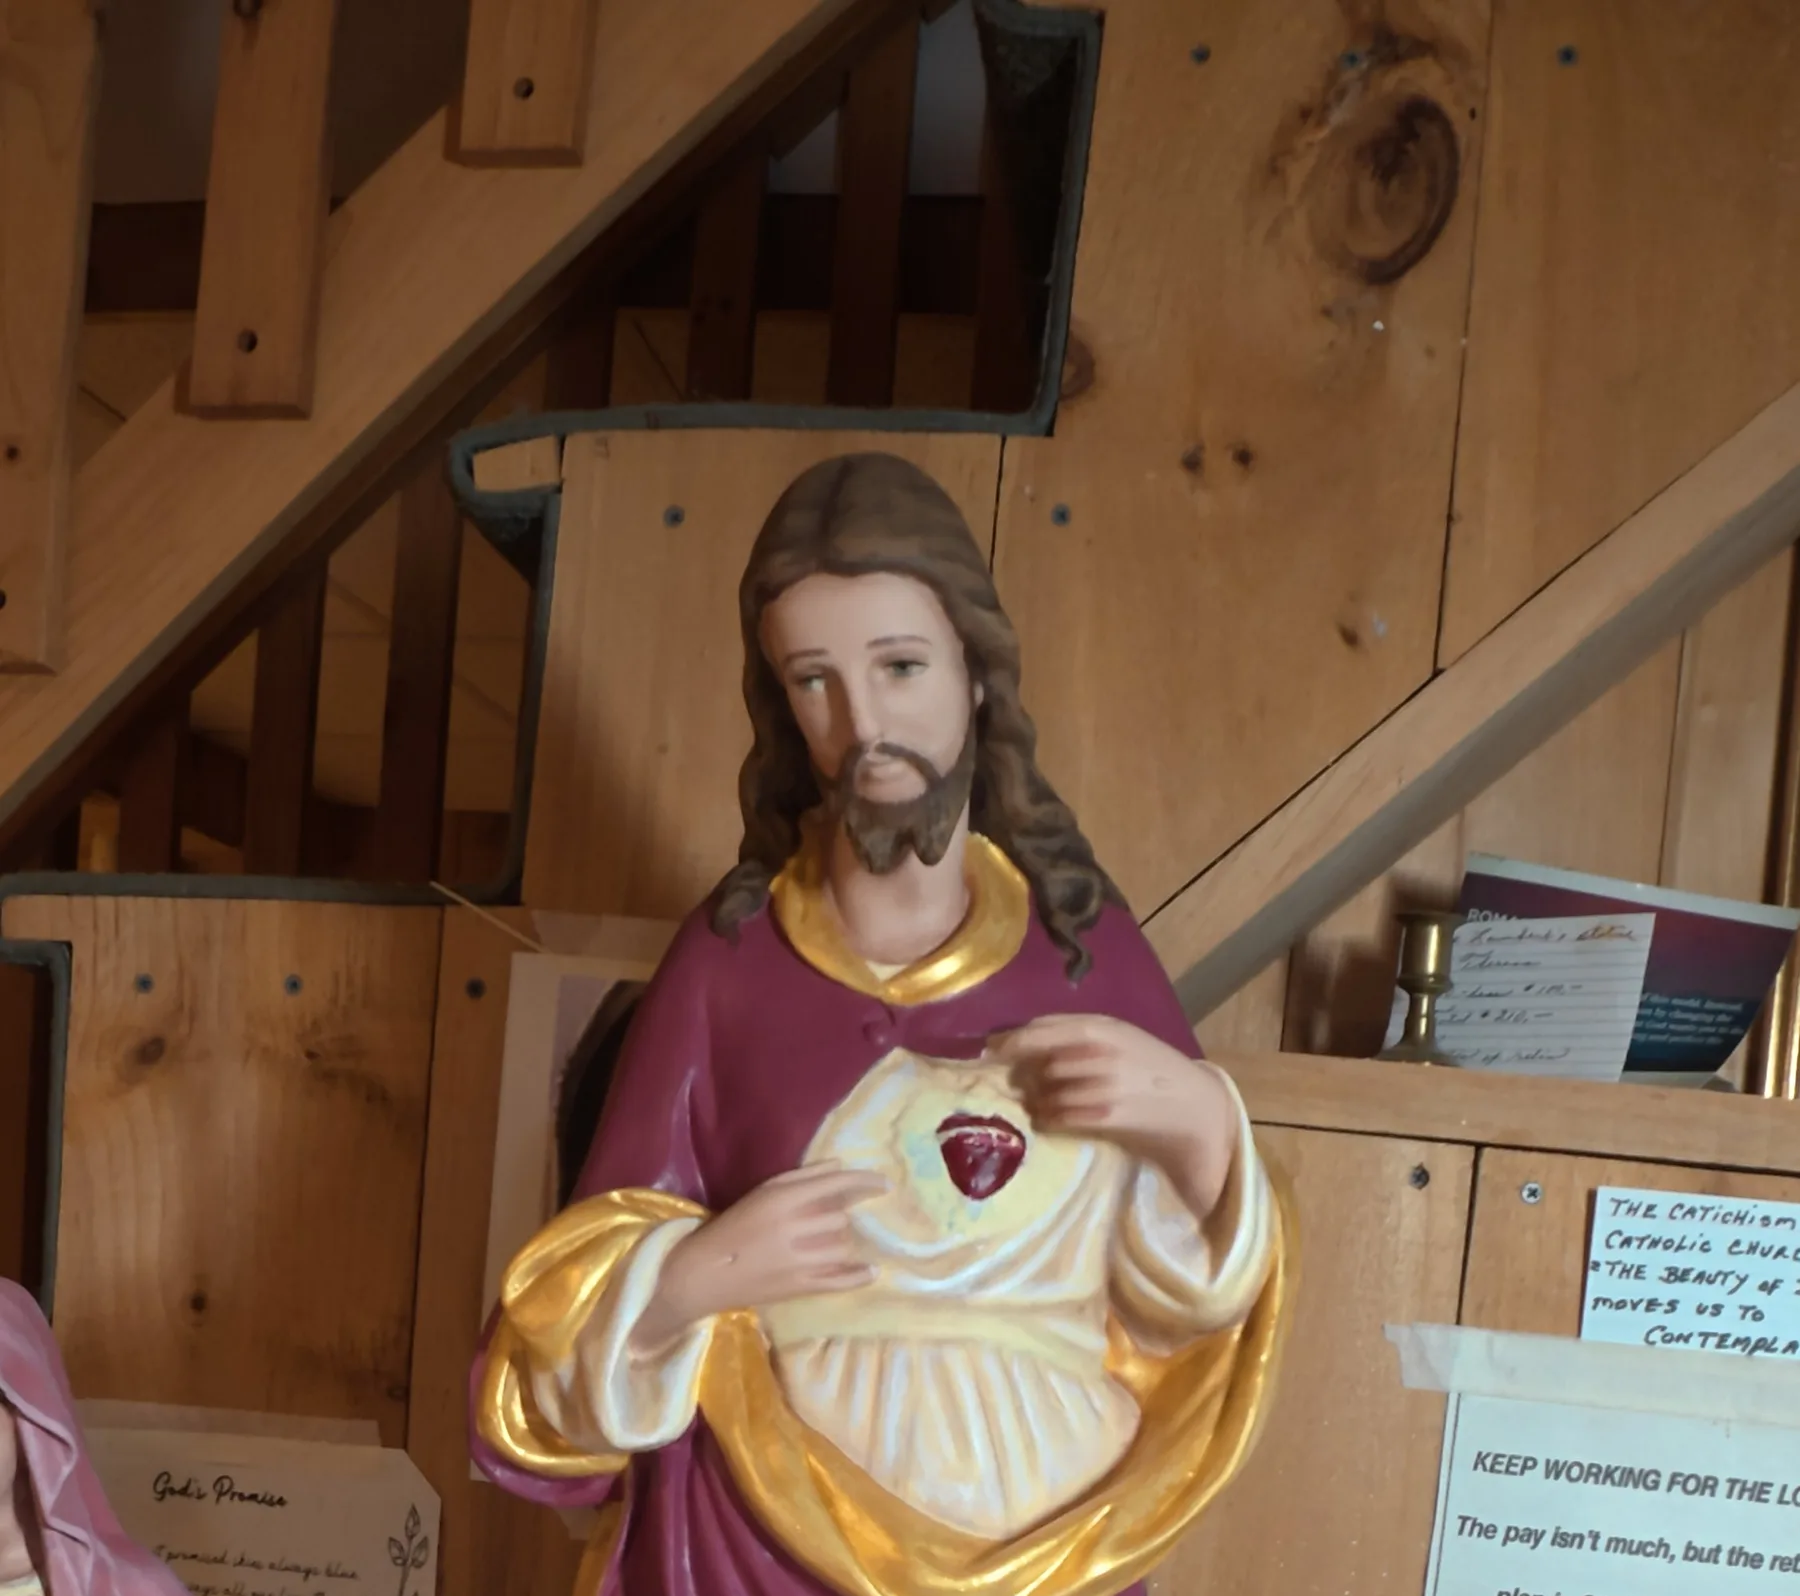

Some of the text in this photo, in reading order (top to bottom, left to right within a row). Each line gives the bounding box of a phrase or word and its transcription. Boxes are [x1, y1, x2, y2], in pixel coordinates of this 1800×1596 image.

[1610, 1197, 1658, 1219] THE
[1658, 1265, 1749, 1296] BEAUTY
[212, 1475, 288, 1507] Promise
[1472, 1451, 1539, 1476] KEEP
[1544, 1458, 1662, 1492] WORKING
[1666, 1471, 1719, 1498] FOR
[1725, 1478, 1774, 1503] THE
[1457, 1515, 1498, 1540] The
[1501, 1525, 1546, 1550] pay
[1550, 1526, 1601, 1551] isn't
[1604, 1535, 1676, 1564] much,
[1682, 1540, 1722, 1565] but
[1726, 1546, 1764, 1570] the
